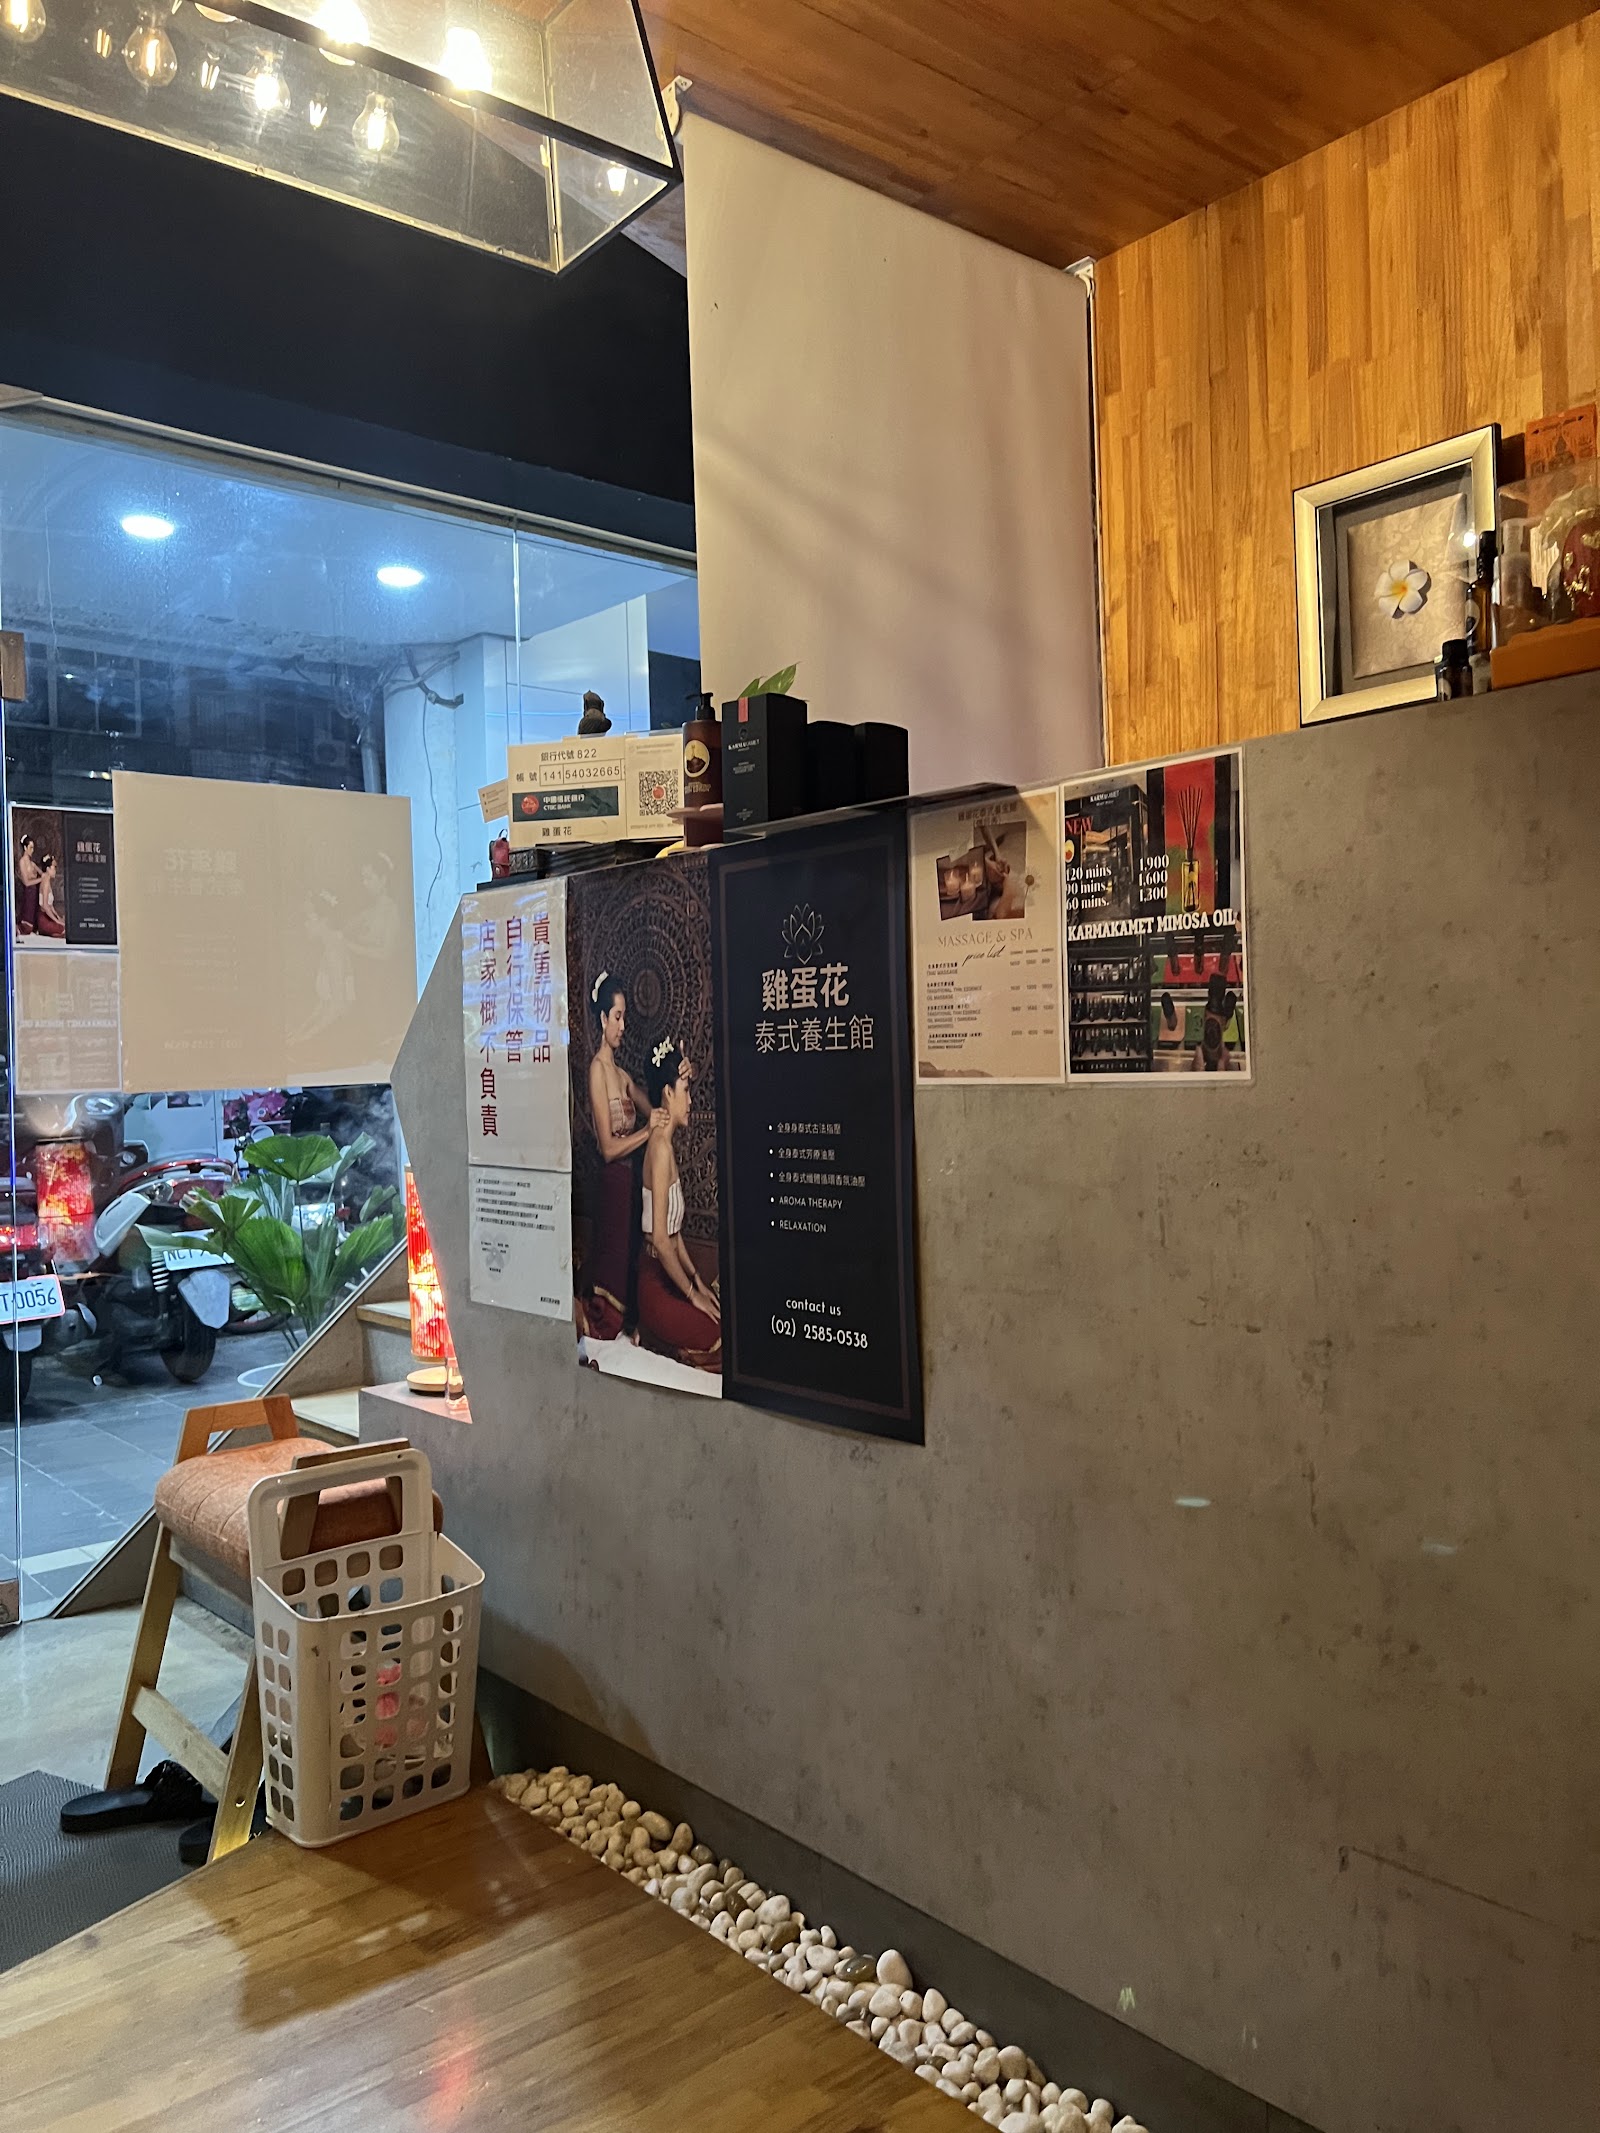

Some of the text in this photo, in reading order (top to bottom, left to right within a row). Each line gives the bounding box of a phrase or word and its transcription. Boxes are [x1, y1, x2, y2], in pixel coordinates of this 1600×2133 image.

[541, 748, 597, 761] 銀行代號 822
[543, 766, 620, 781] 141 54032665
[1066, 816, 1093, 836] NEW
[1066, 867, 1083, 881] 120
[1066, 897, 1079, 911] 60
[1068, 907, 1236, 941] KARMAKAMET MIMOSA OIL
[938, 931, 993, 948] MASSAGE
[1010, 927, 1033, 941] SPA
[505, 915, 524, 1063] 自行保管
[532, 911, 551, 1063] 貴重物品
[761, 962, 850, 1012] 雞蛋花
[479, 918, 498, 1137] 店家概不負責
[755, 1014, 874, 1053] 泰式養生館
[779, 1196, 843, 1209] AROMA THERAPY
[779, 1220, 827, 1233] RELAXATION
[786, 1299, 841, 1316] contact us
[771, 1314, 868, 1349] (02) 2585-0538
